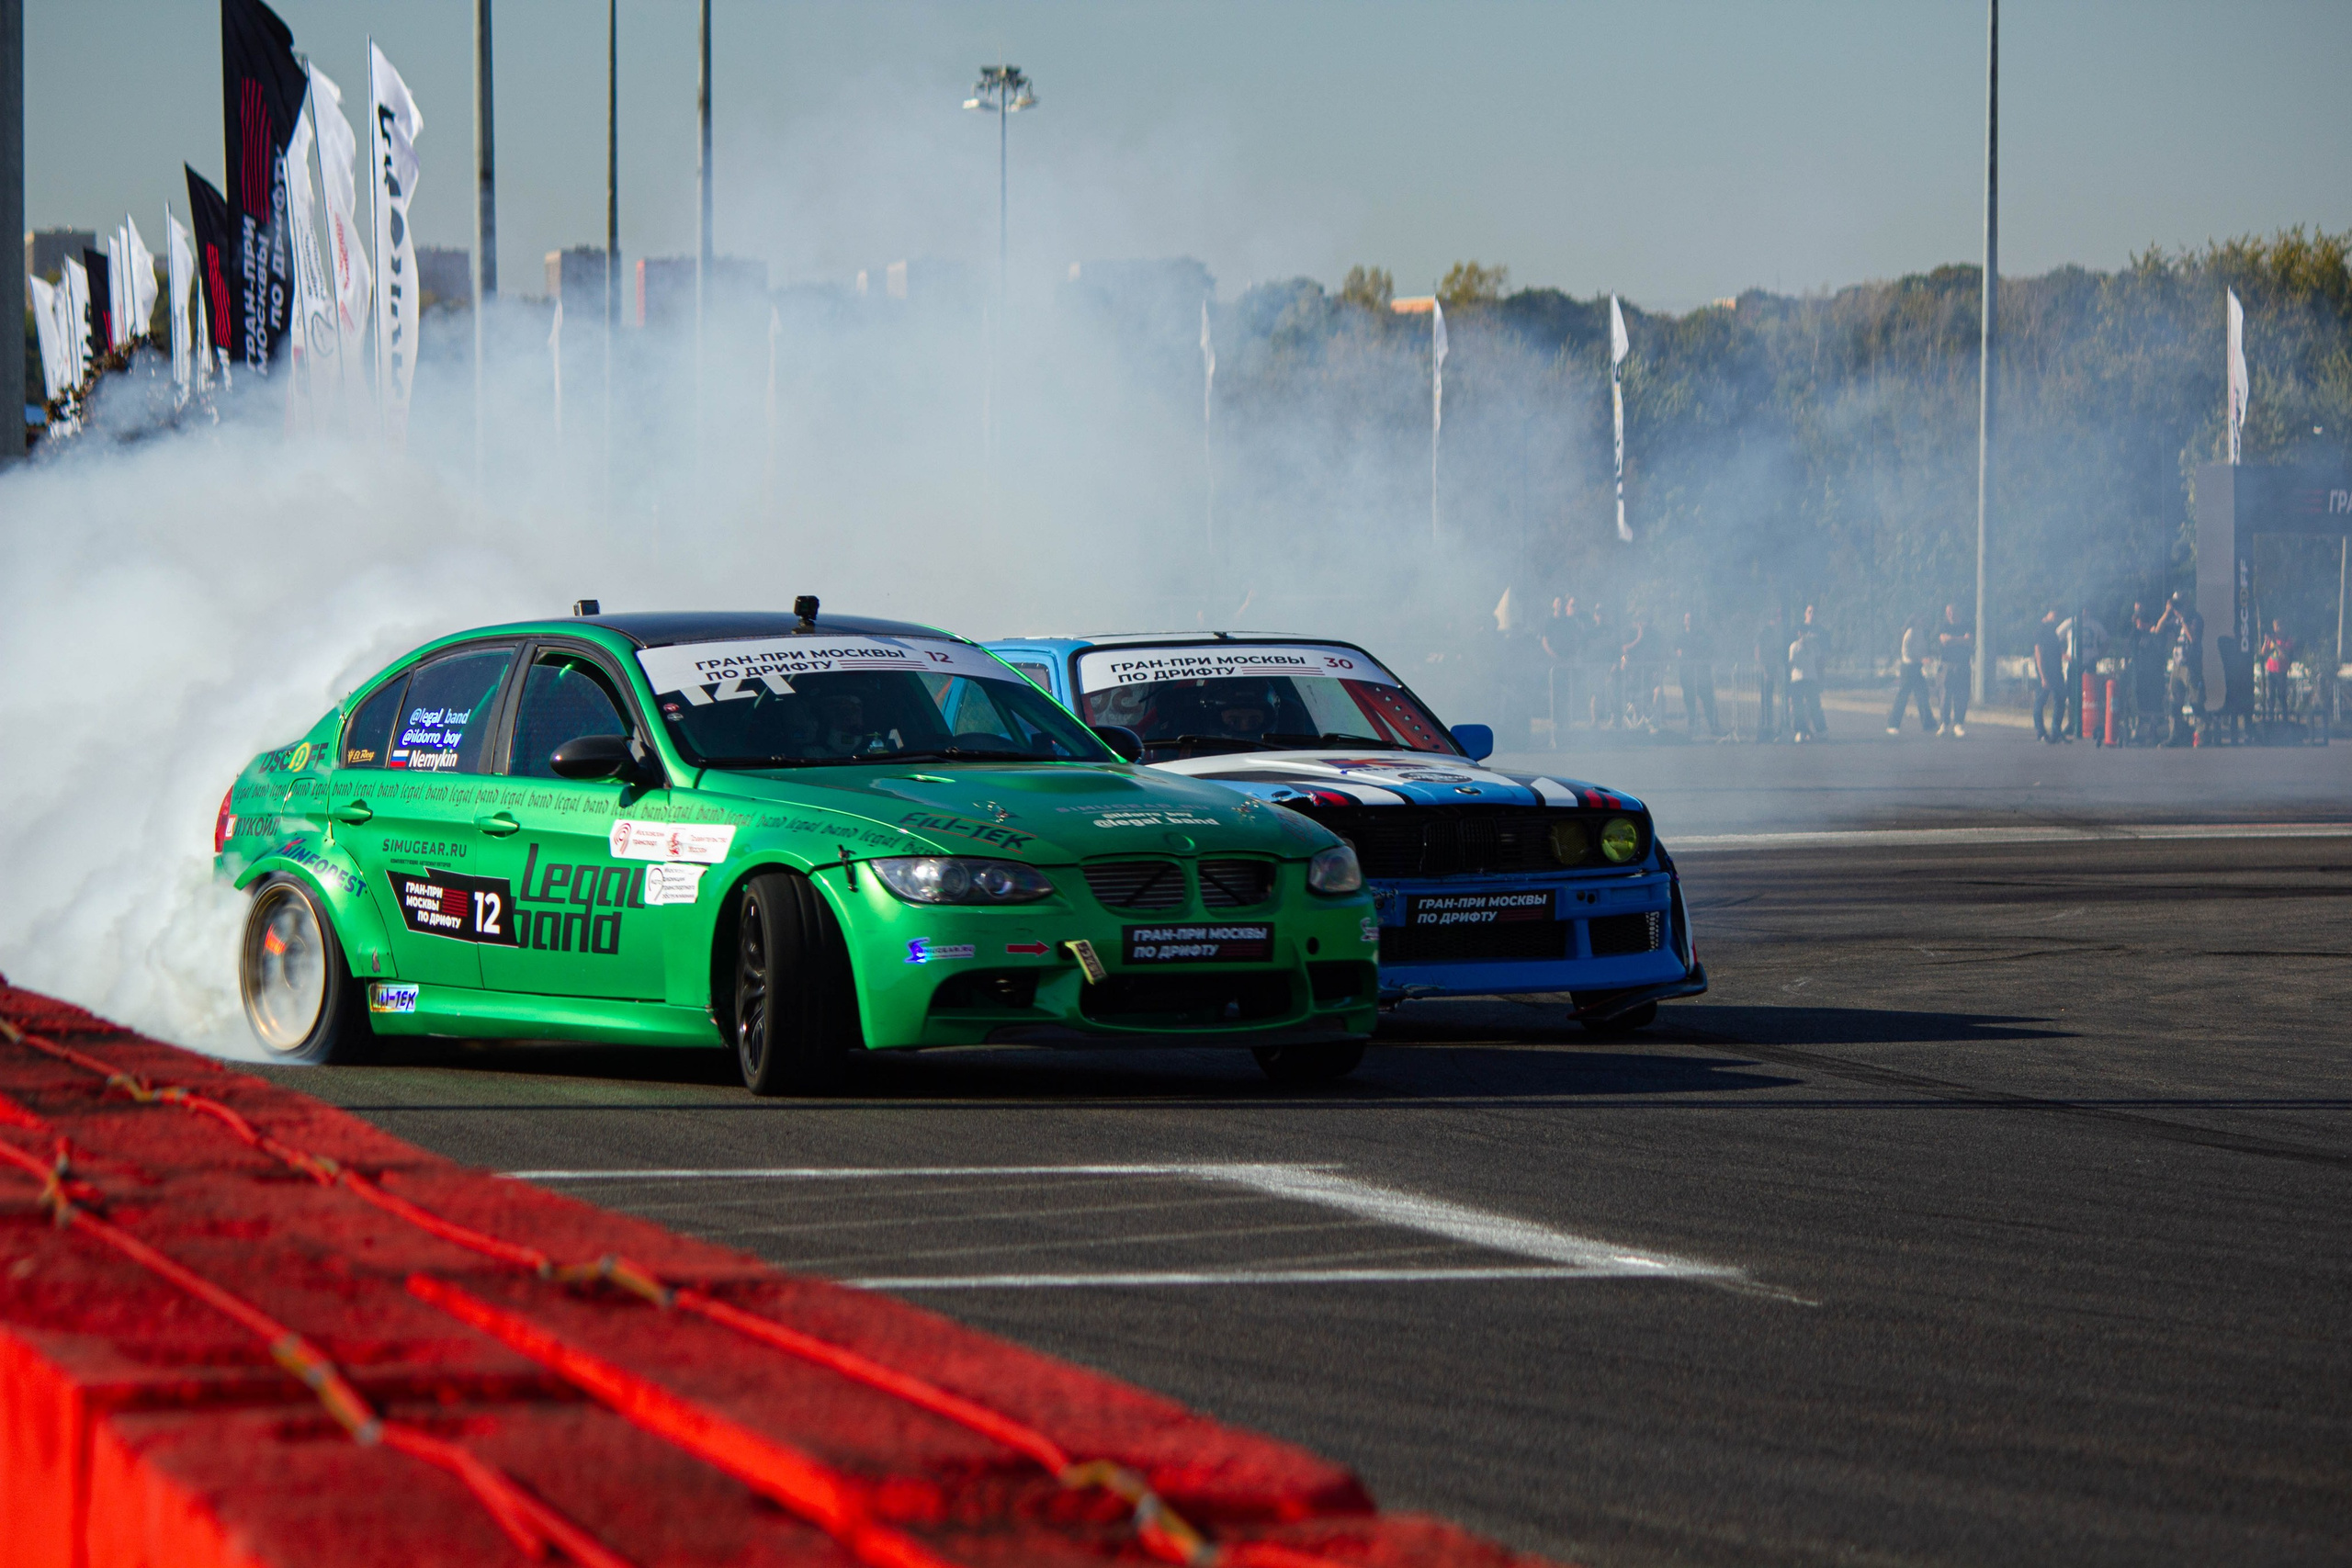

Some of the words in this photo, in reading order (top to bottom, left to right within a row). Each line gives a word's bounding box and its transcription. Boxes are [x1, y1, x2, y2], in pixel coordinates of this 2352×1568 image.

[243, 214, 256, 371] ГРАН-ПРИ
[255, 232, 269, 376] МОСКВЫ
[271, 281, 284, 331] ПО
[695, 651, 807, 671] ГРАН-ПРИ
[810, 649, 906, 660] МОСКВЫ
[924, 650, 954, 663] 12
[1111, 656, 1211, 672] ГРАН-ПРИ
[1216, 656, 1306, 666] МОСКВЫ
[1323, 657, 1353, 670] 30
[705, 668, 739, 682] ПО
[744, 660, 832, 678] ДРИФТУ
[1118, 671, 1148, 683] ПО
[1154, 666, 1236, 681] ДРИФТУ
[409, 707, 471, 727] @legal_band
[409, 749, 458, 772] Nemykin
[233, 813, 281, 837] ЛУКОЙЛ
[382, 838, 467, 858] SIMUGEAR.RU
[405, 881, 443, 899] ГРАН-ПРИ
[406, 895, 439, 911] МОСКВЫ
[1418, 897, 1487, 909] ГРАН-ПРИ
[1488, 894, 1546, 907] МОСКВЫ
[417, 909, 429, 923] ПО
[429, 912, 461, 929] ДРИФТУ
[474, 891, 501, 934] 12
[1417, 913, 1438, 924] ПО
[1439, 910, 1498, 925] ДРИФТУ
[1133, 928, 1206, 942] ГРАН-ПРИ
[1208, 927, 1267, 940] МОСКВЫ
[1133, 945, 1156, 958] ПО
[1158, 944, 1219, 960] ДРИФТУ
